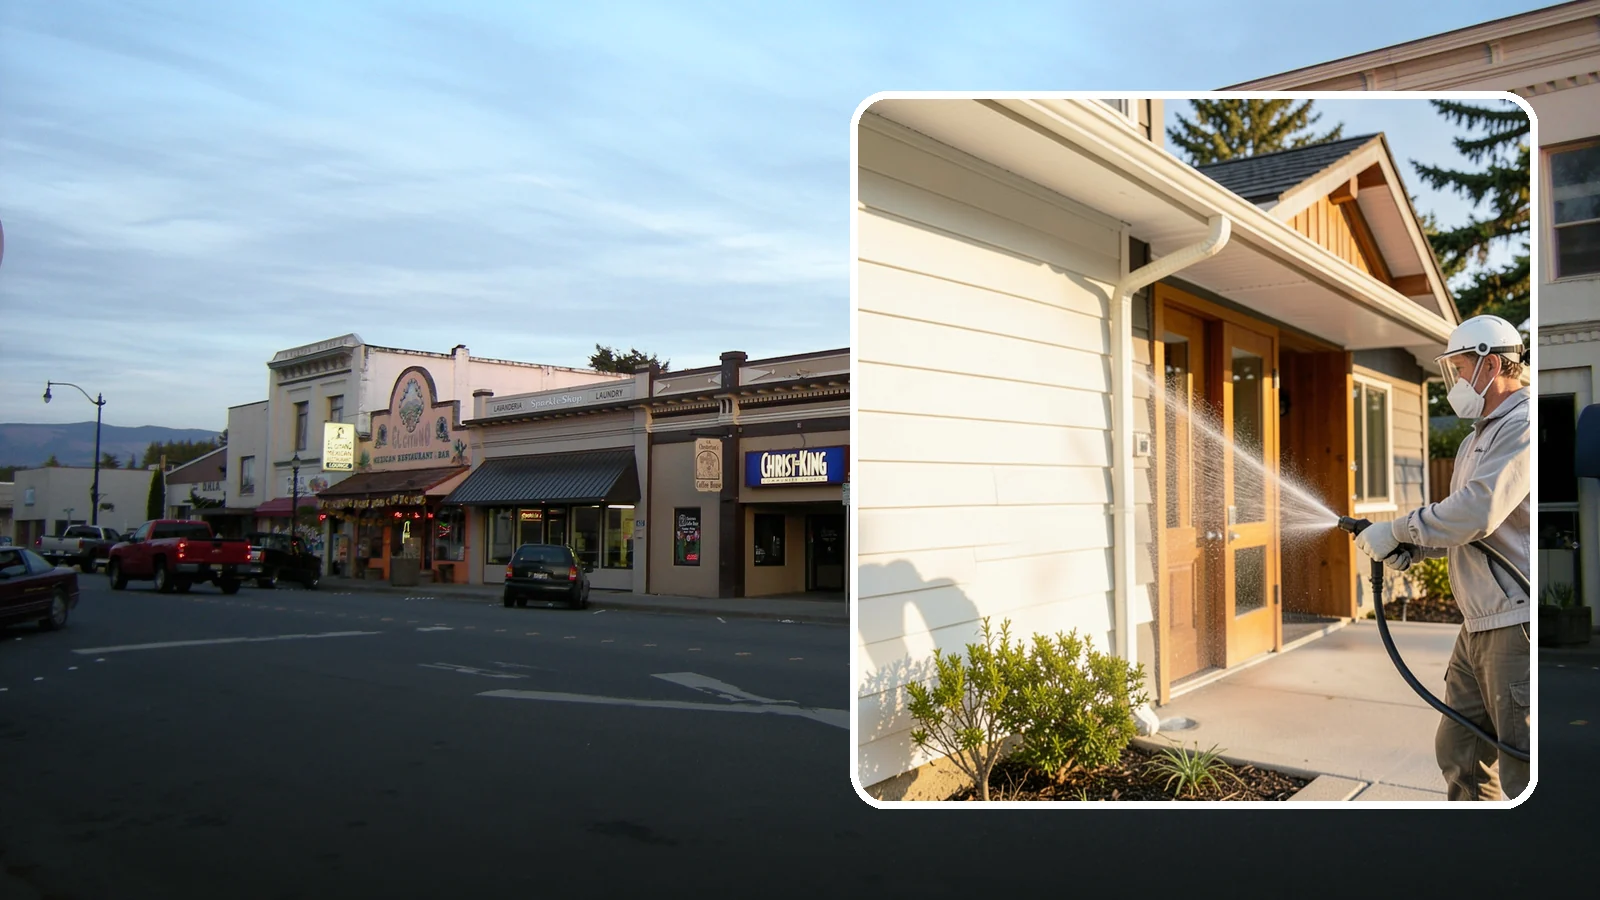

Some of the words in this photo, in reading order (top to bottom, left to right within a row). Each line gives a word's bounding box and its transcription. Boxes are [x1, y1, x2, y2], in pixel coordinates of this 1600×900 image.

[595, 389, 624, 400] LAUNDRY
[493, 402, 522, 413] LAVANDERIA
[391, 425, 402, 449] EL
[373, 455, 396, 465] MEXICAN
[397, 451, 433, 463] RESTAURANT
[437, 450, 450, 459] BAR
